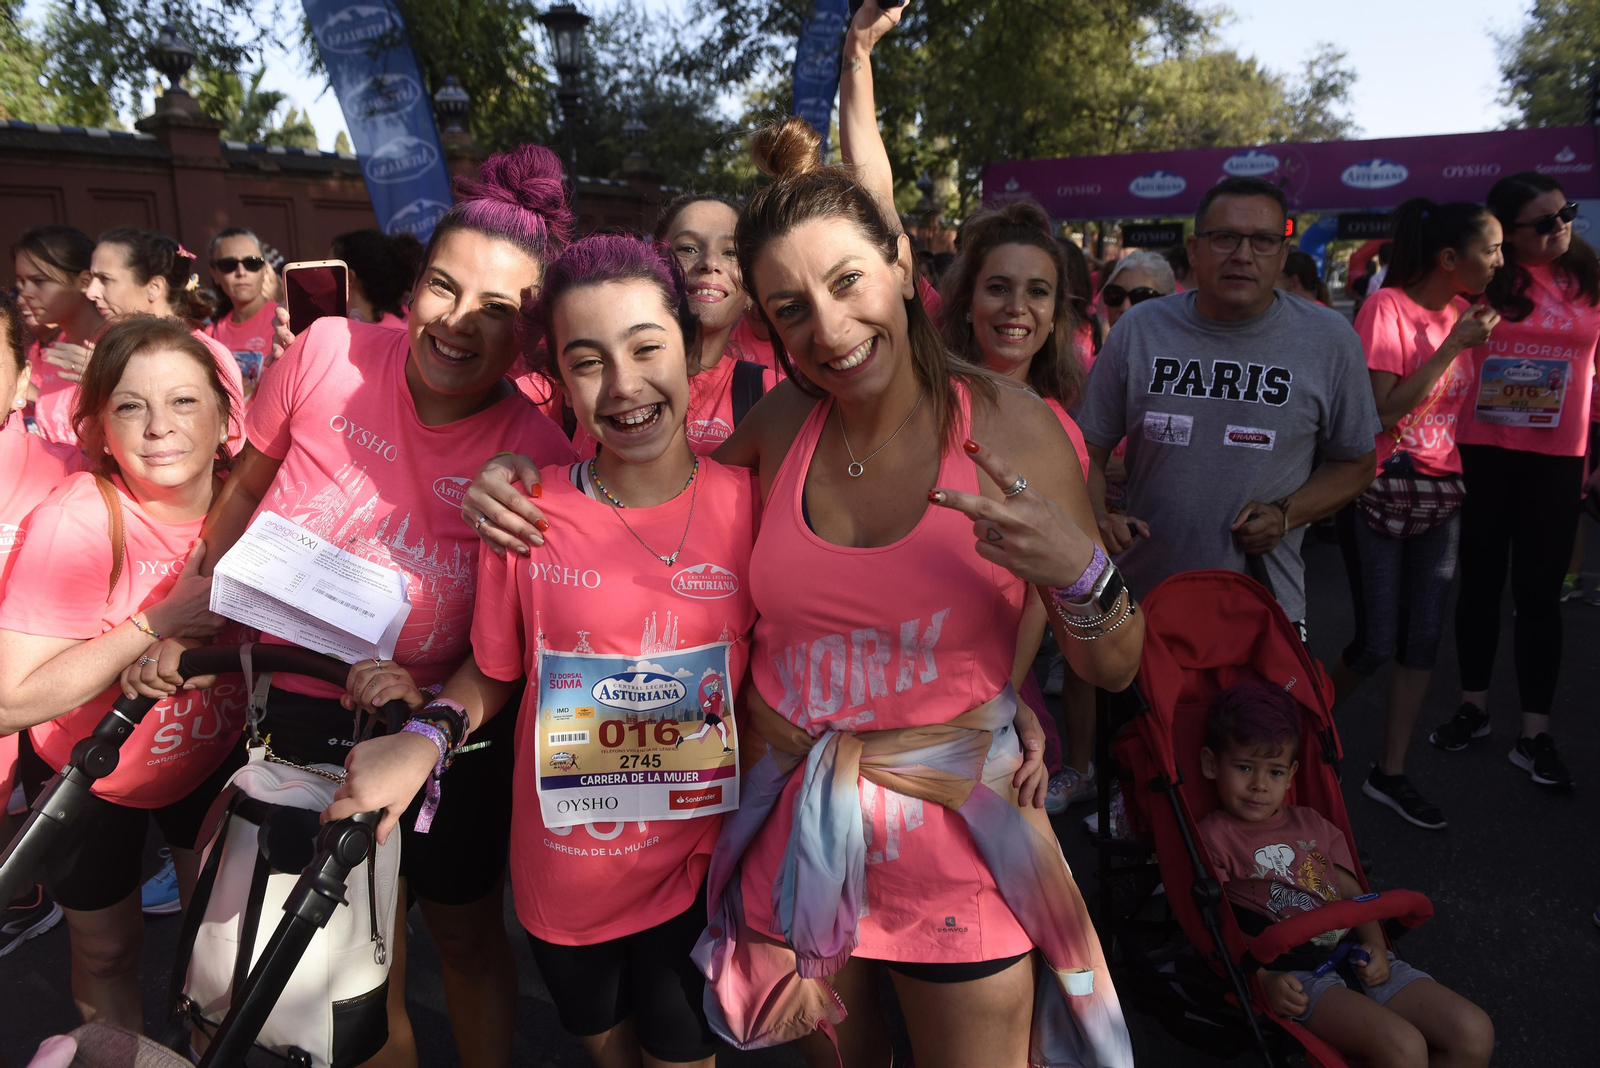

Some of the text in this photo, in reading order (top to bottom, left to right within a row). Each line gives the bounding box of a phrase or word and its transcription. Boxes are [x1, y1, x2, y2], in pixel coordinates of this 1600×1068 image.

[1442, 163, 1501, 178] OYSHO
[1514, 343, 1580, 359] DORSAL
[1148, 356, 1293, 407] PARIS
[1503, 385, 1537, 398] 016
[330, 415, 398, 462] OYSHO
[1232, 434, 1265, 442] FRANCE
[529, 562, 601, 589] OYSHO
[677, 576, 735, 590] ASTURIANA
[773, 607, 950, 727] WORK
[558, 672, 583, 680] DORSAL
[550, 679, 583, 690] SUMA
[645, 682, 677, 690] LECHERA
[599, 685, 681, 702] ASTURIANA
[154, 699, 192, 723] TU
[599, 719, 681, 748] 016
[147, 750, 190, 766] CARRERA
[619, 754, 662, 769] 2745
[580, 772, 699, 786] CARRERA DE LA MUJER
[557, 796, 619, 814] OYSHO
[685, 793, 715, 804] Santander
[543, 836, 659, 857] CARRERA DE LA MUJER
